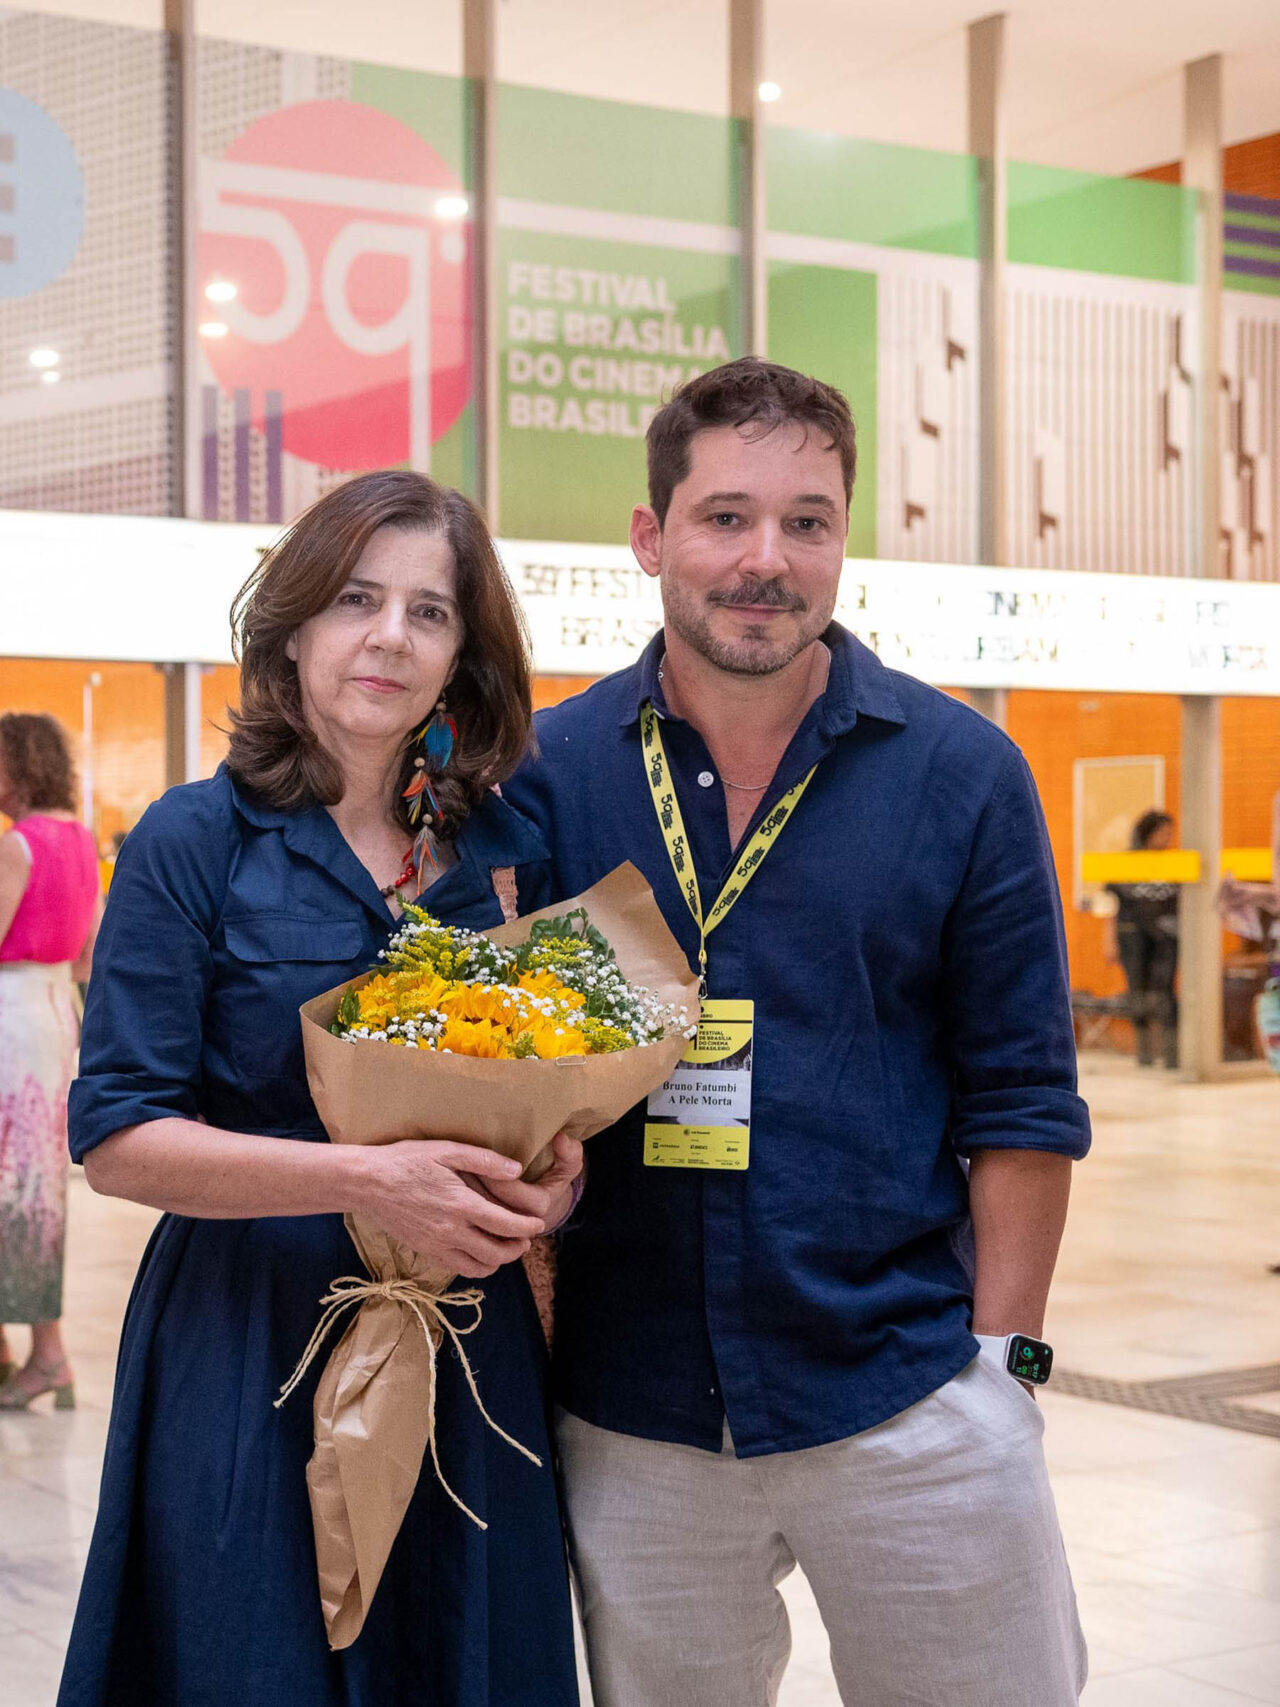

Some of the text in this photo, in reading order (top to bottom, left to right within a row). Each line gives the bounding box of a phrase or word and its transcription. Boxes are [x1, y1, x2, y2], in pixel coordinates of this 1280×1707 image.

[507, 259, 677, 313] FESTIVAL
[507, 306, 730, 359] DE BRASÍLIA
[507, 350, 562, 387] DO
[662, 1081, 737, 1093] Bruno Fatumbi
[668, 1095, 732, 1106] A Pele Morta
